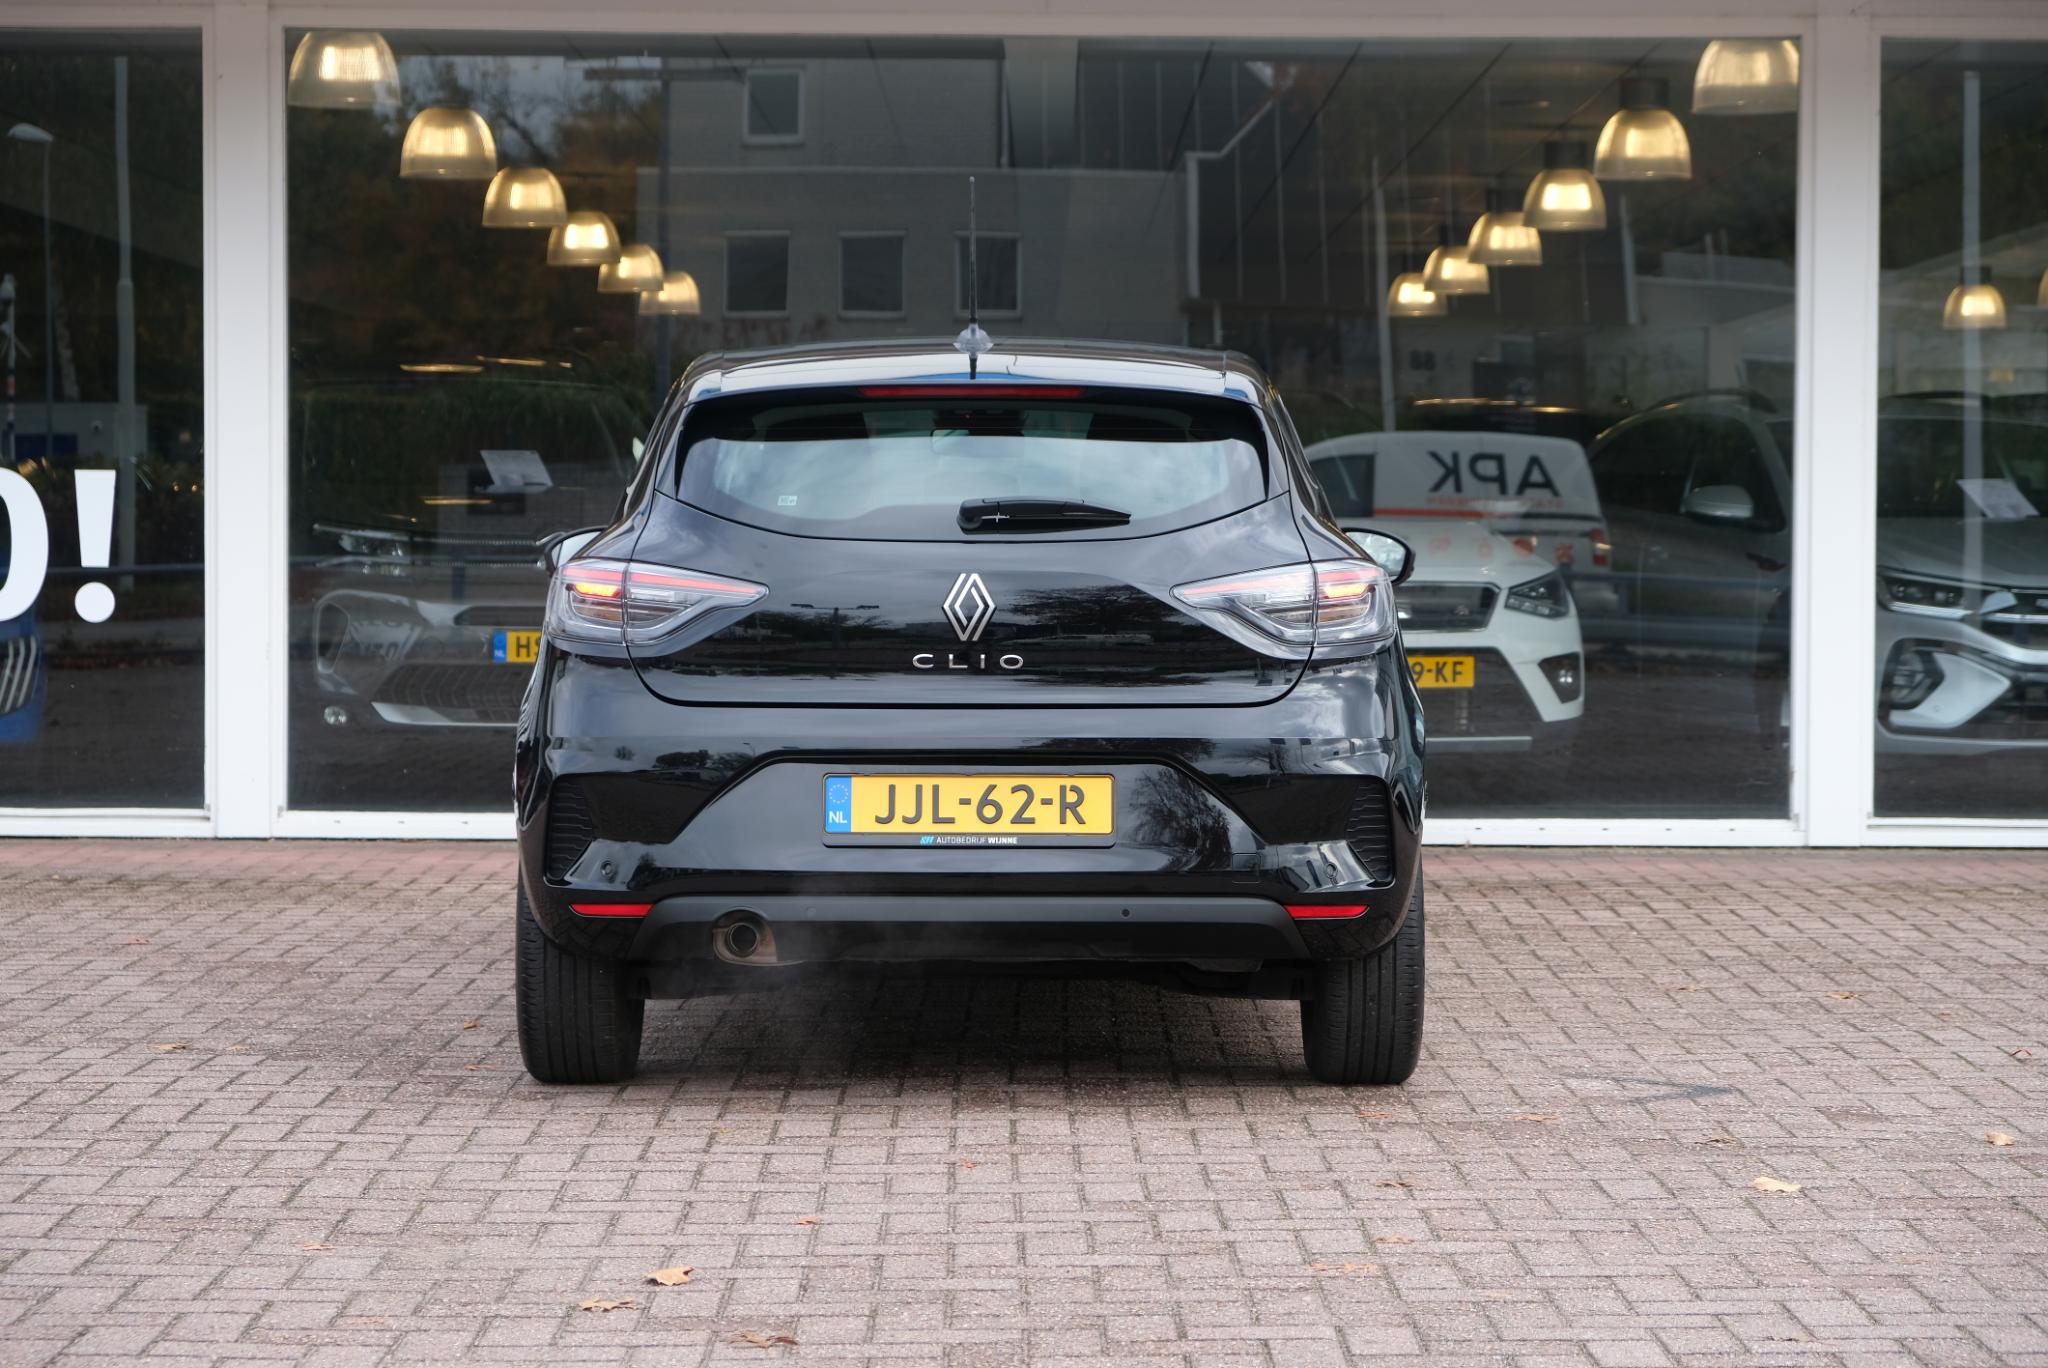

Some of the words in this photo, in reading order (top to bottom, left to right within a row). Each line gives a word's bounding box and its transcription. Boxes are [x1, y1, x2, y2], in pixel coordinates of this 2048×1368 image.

[912, 653, 1024, 670] CLIO
[829, 811, 848, 824] NL
[875, 784, 1086, 825] JJL-62-R
[936, 836, 985, 844] AUTOBEDRIJF
